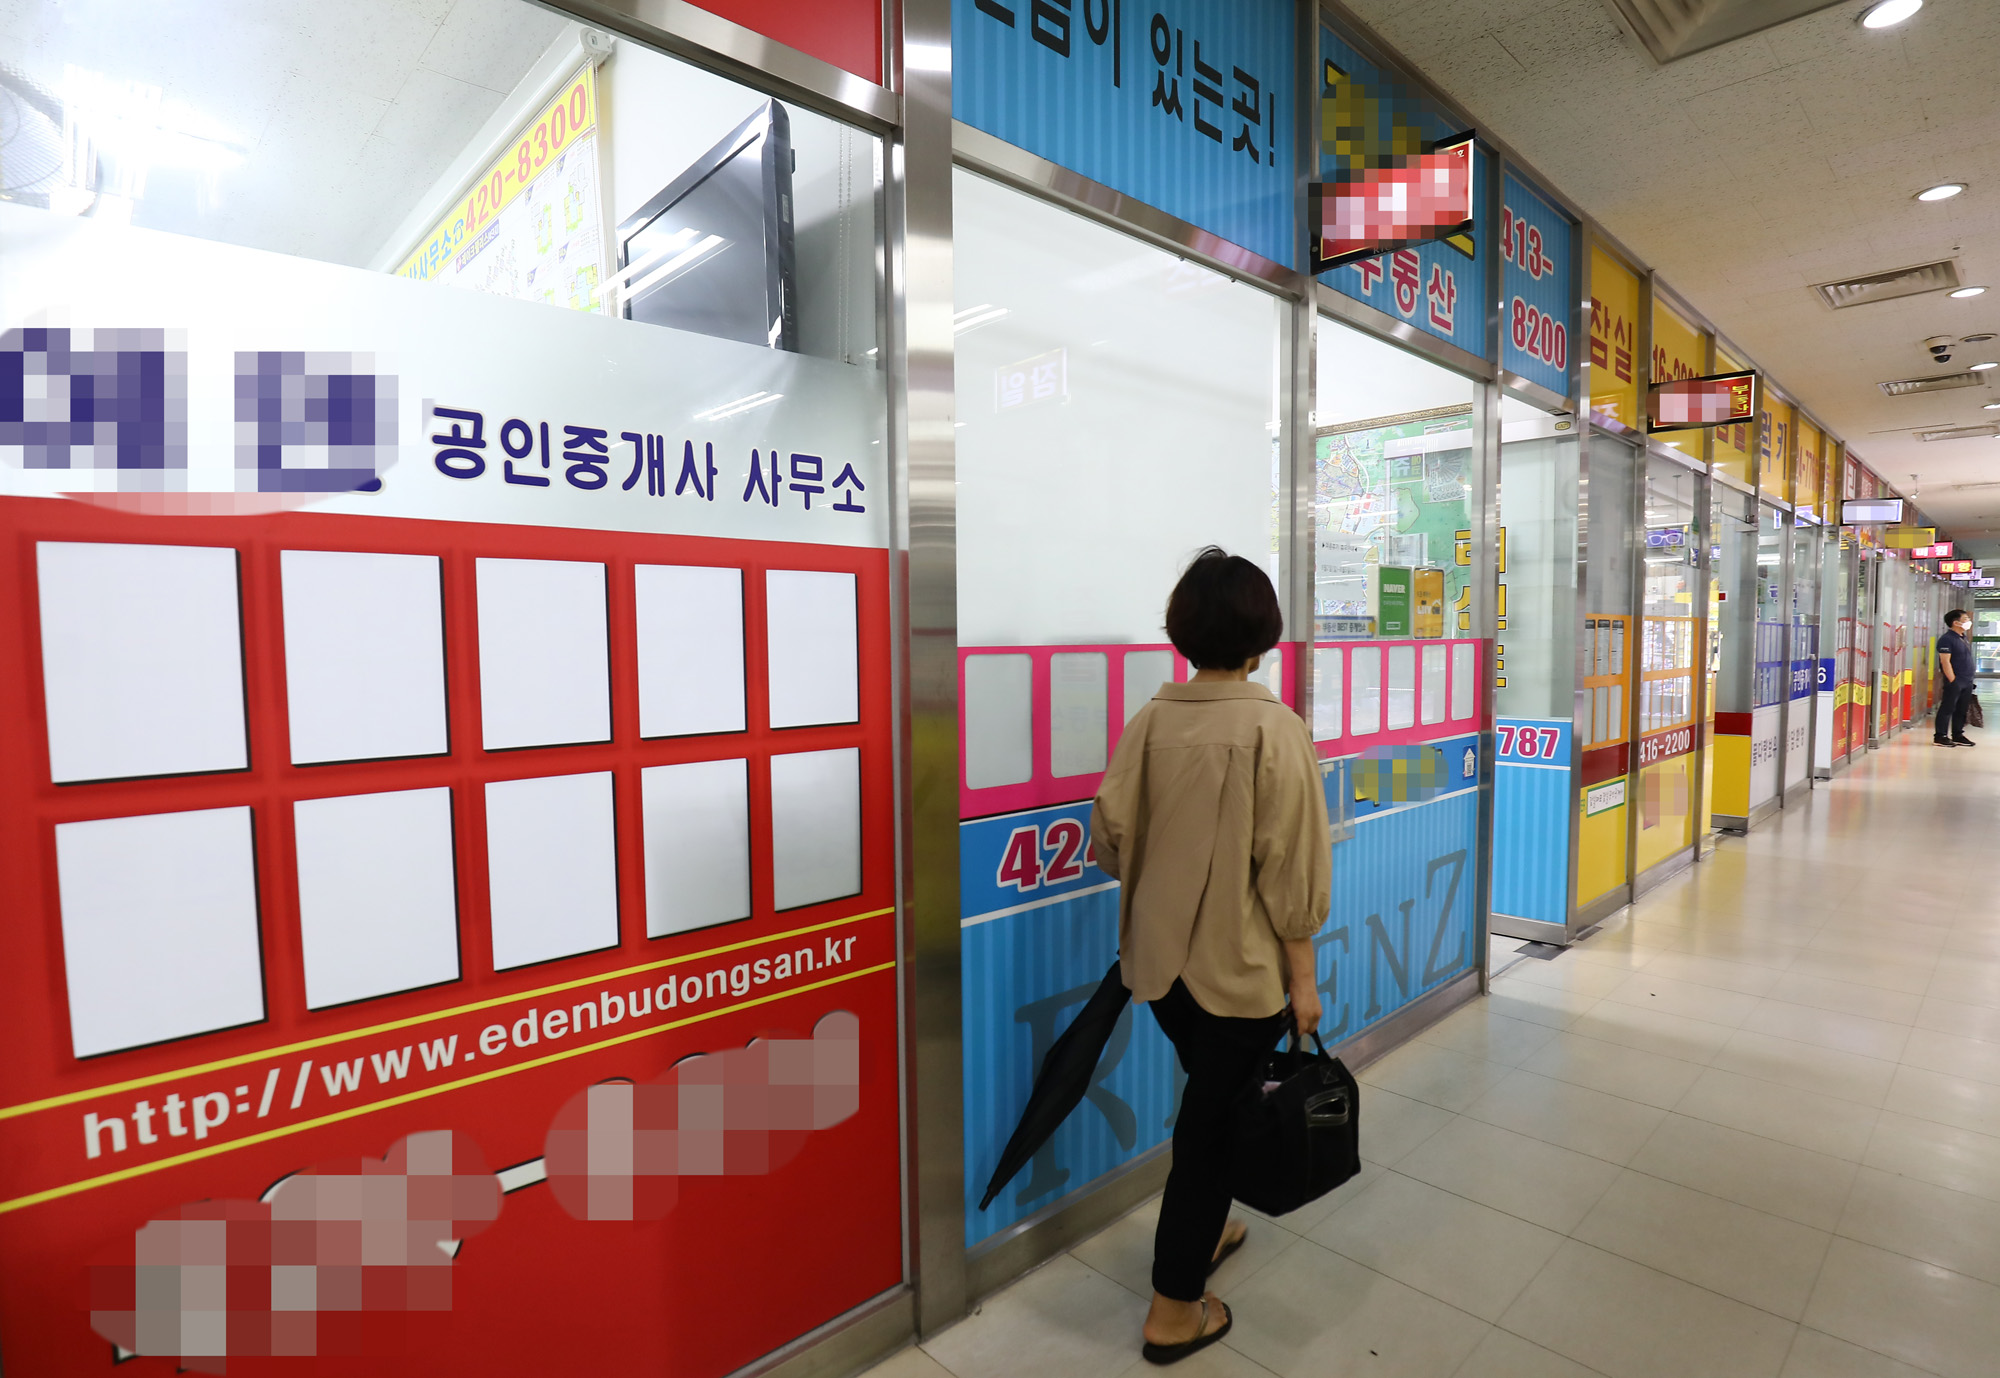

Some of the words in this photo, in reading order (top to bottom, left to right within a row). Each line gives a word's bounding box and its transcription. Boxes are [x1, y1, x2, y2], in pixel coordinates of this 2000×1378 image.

[464, 83, 587, 233] 420-8300
[1512, 297, 1567, 372] 8200
[1591, 297, 1631, 384] 잠실
[431, 406, 718, 501] 공인중개사
[743, 448, 866, 513] 사무소
[1383, 584, 1406, 593] NAVER
[1640, 729, 1690, 762] 416-2200
[82, 934, 857, 1158] http://www.edenbudongsan.kr
